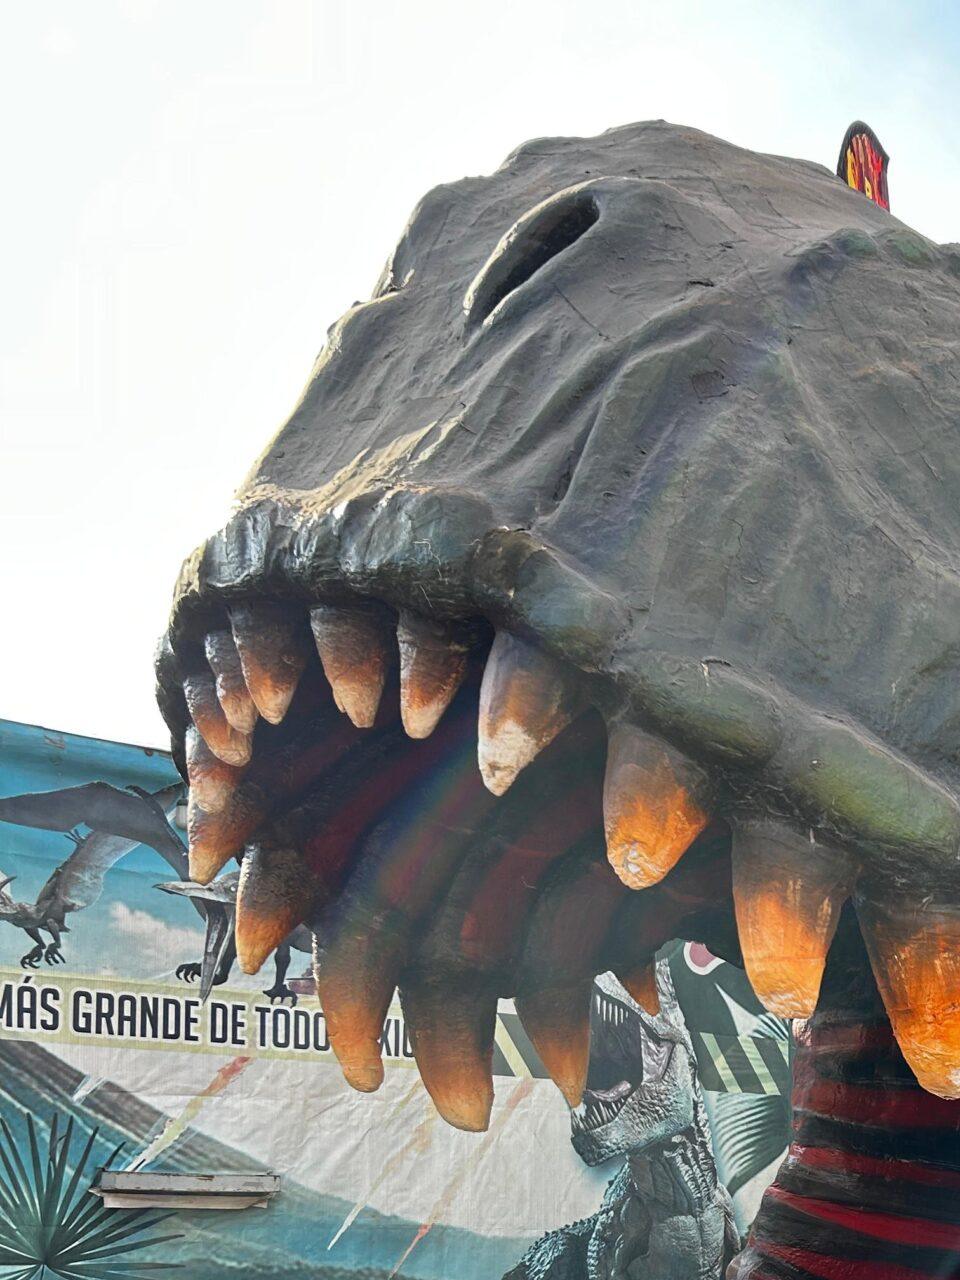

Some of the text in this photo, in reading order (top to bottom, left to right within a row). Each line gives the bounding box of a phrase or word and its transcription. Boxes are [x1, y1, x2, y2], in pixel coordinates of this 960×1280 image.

[72, 990, 200, 1042] GRANDE
[210, 1002, 246, 1046] DE
[255, 1006, 331, 1052] TODO
